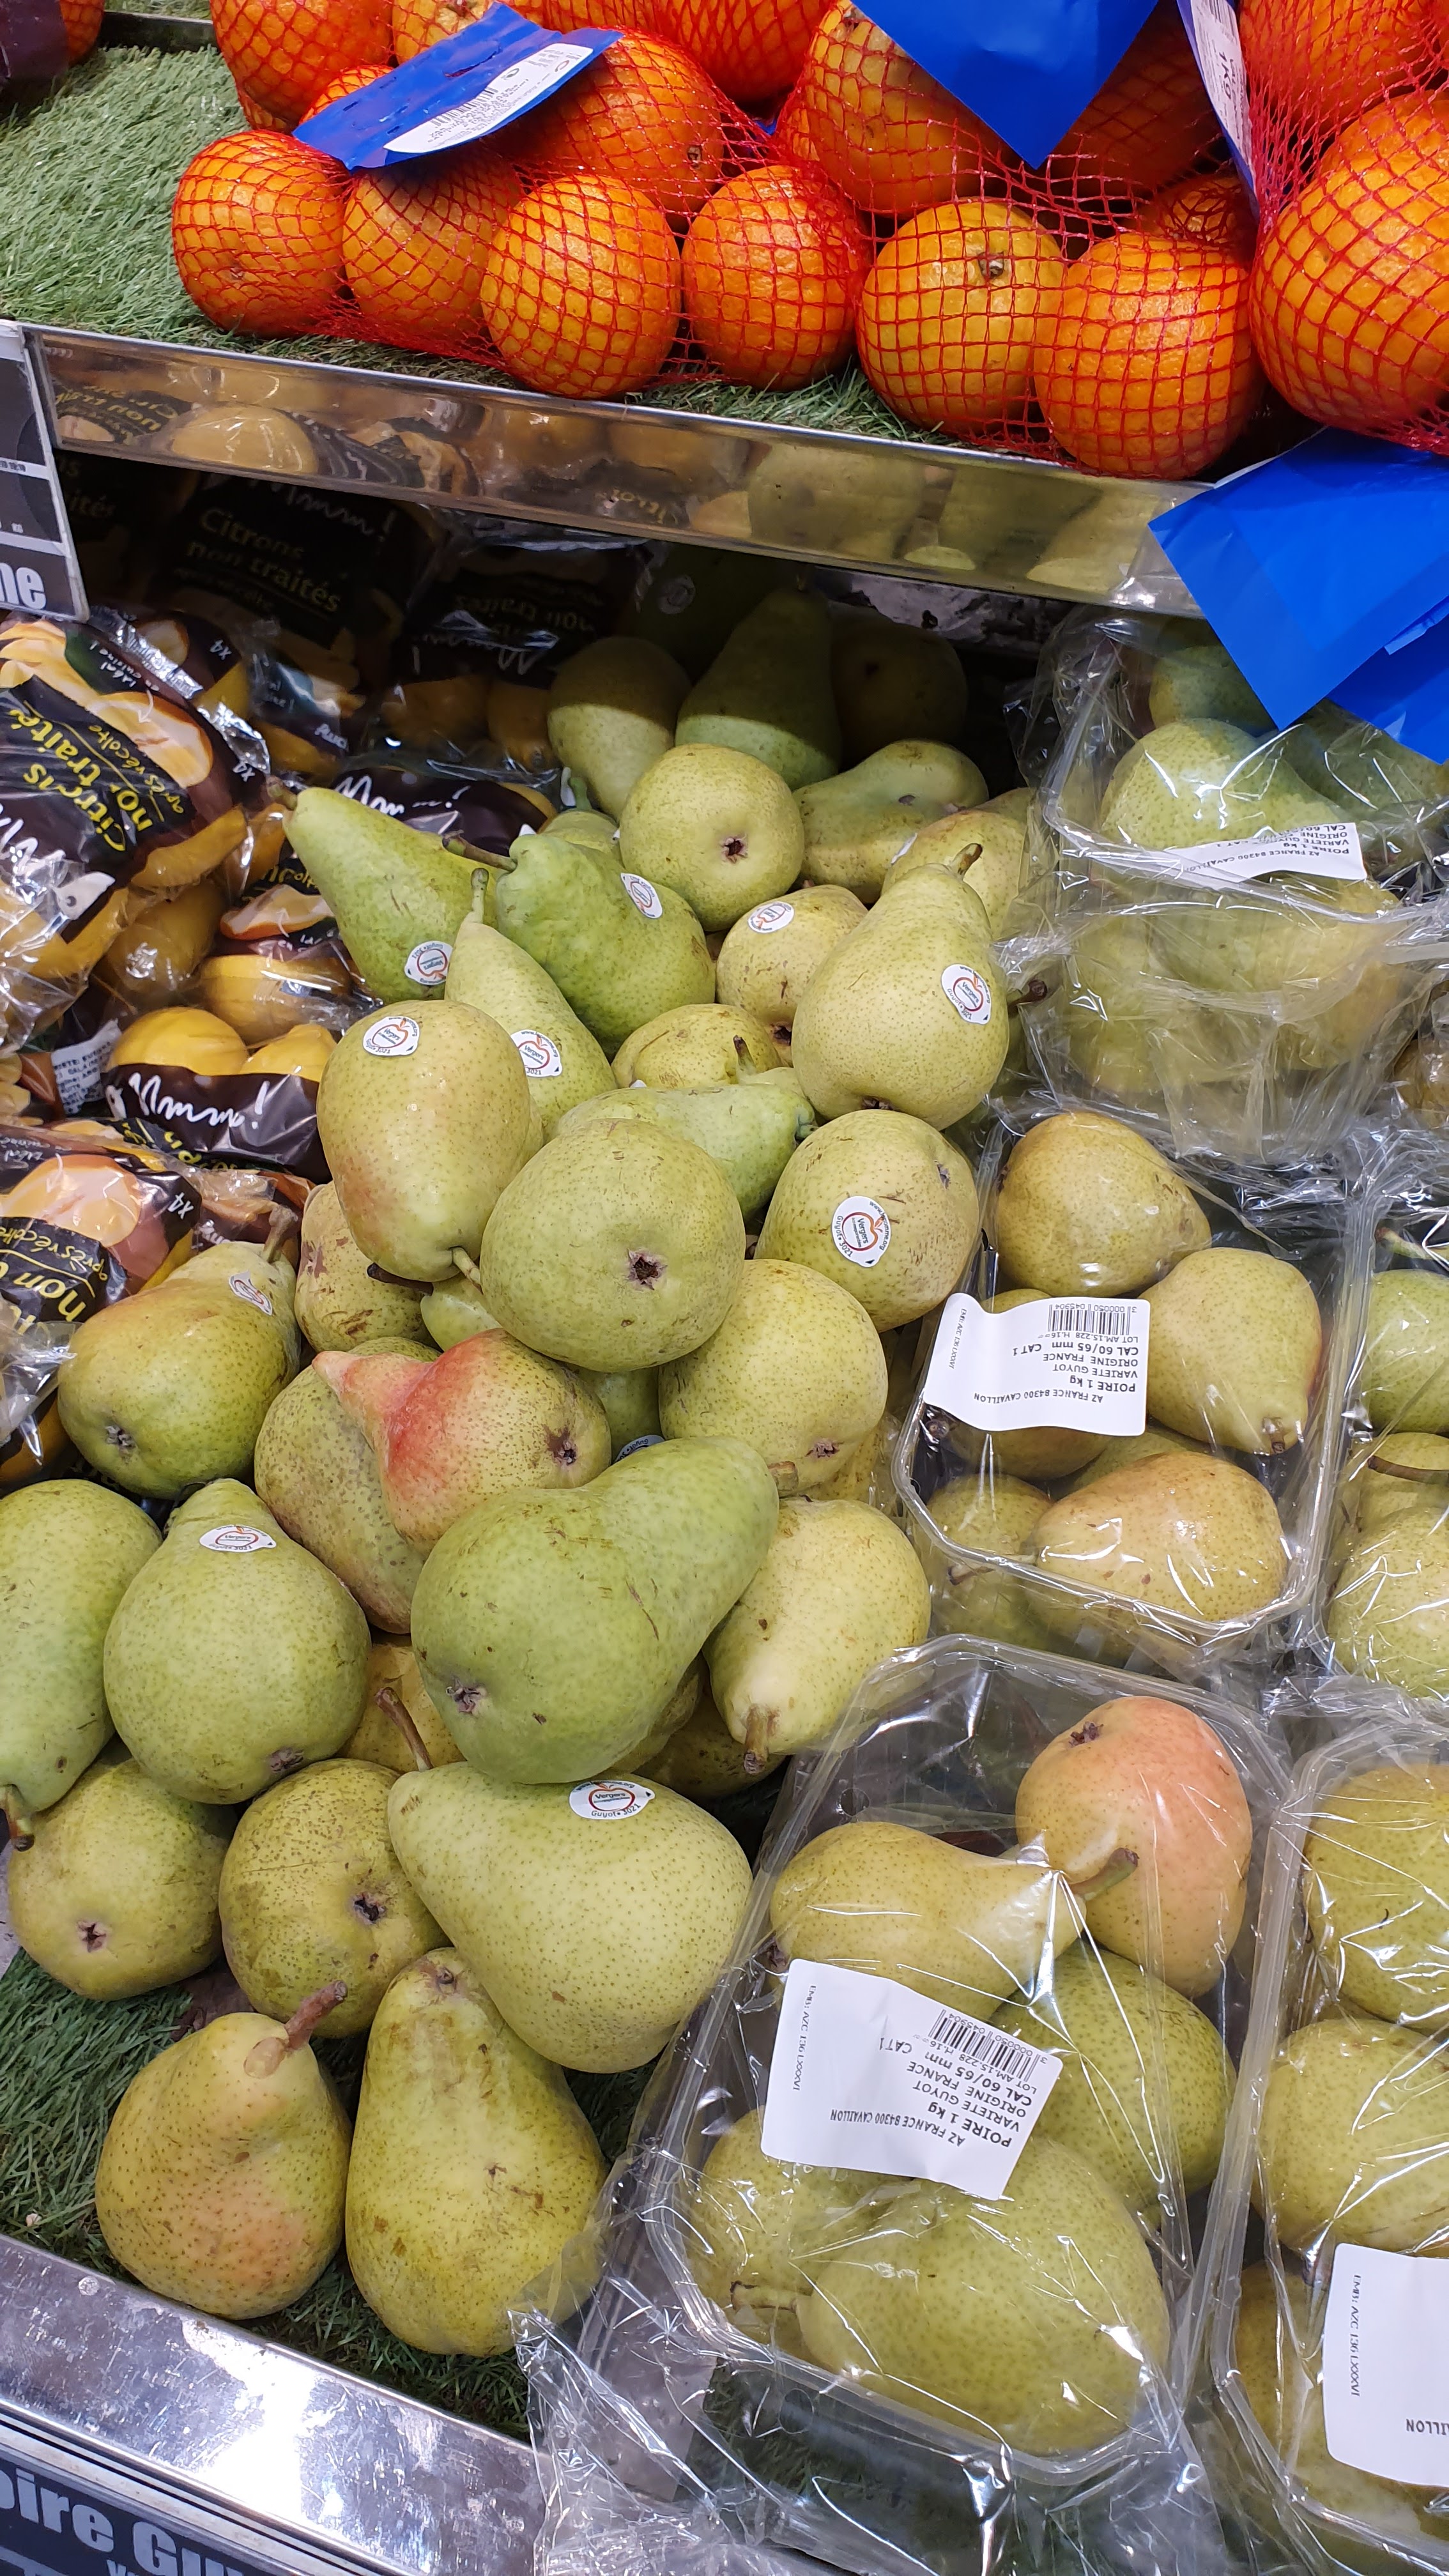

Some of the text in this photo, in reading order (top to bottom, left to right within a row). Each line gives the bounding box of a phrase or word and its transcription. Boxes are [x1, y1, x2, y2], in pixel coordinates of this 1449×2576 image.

[110, 783, 153, 831] no
[1304, 837, 1349, 846] VARIETE
[1238, 851, 1267, 861] 84300
[525, 1045, 544, 1060] Vergers
[834, 1215, 854, 1257] Guyot 3021
[857, 1218, 869, 1244] Vergers
[13, 1272, 87, 1322] non
[1021, 1344, 1042, 1353] CAT
[1078, 1343, 1113, 1354] 60/65
[1113, 1347, 1139, 1356] CAL
[1043, 1353, 1138, 1367] ORIGINE FRANCE
[1053, 1363, 1138, 1378] VARIETE GUYOT
[1070, 1376, 1136, 1392] POIRE 1 kg
[974, 1392, 1021, 1403] CAVAILLON
[1024, 1389, 1050, 1399] 84300
[1052, 1390, 1089, 1401] FRANCE
[623, 1803, 641, 1815] 3021
[948, 2012, 986, 2035] 045904
[885, 2037, 913, 2055] CAT
[994, 2034, 1033, 2056] 000050
[924, 2053, 954, 2070] mm
[955, 2066, 1002, 2095] 60/65
[1014, 2080, 1037, 2095] LOT
[907, 2061, 1027, 2118] ORIGINE FRANCE
[1004, 2087, 1033, 2106] CAL
[912, 2080, 1021, 2133] VARIETE GUYOT
[830, 2109, 966, 2147] AZ FRANCE 84300 CAVAILLON
[928, 2101, 1013, 2148] POIRE 1 kg
